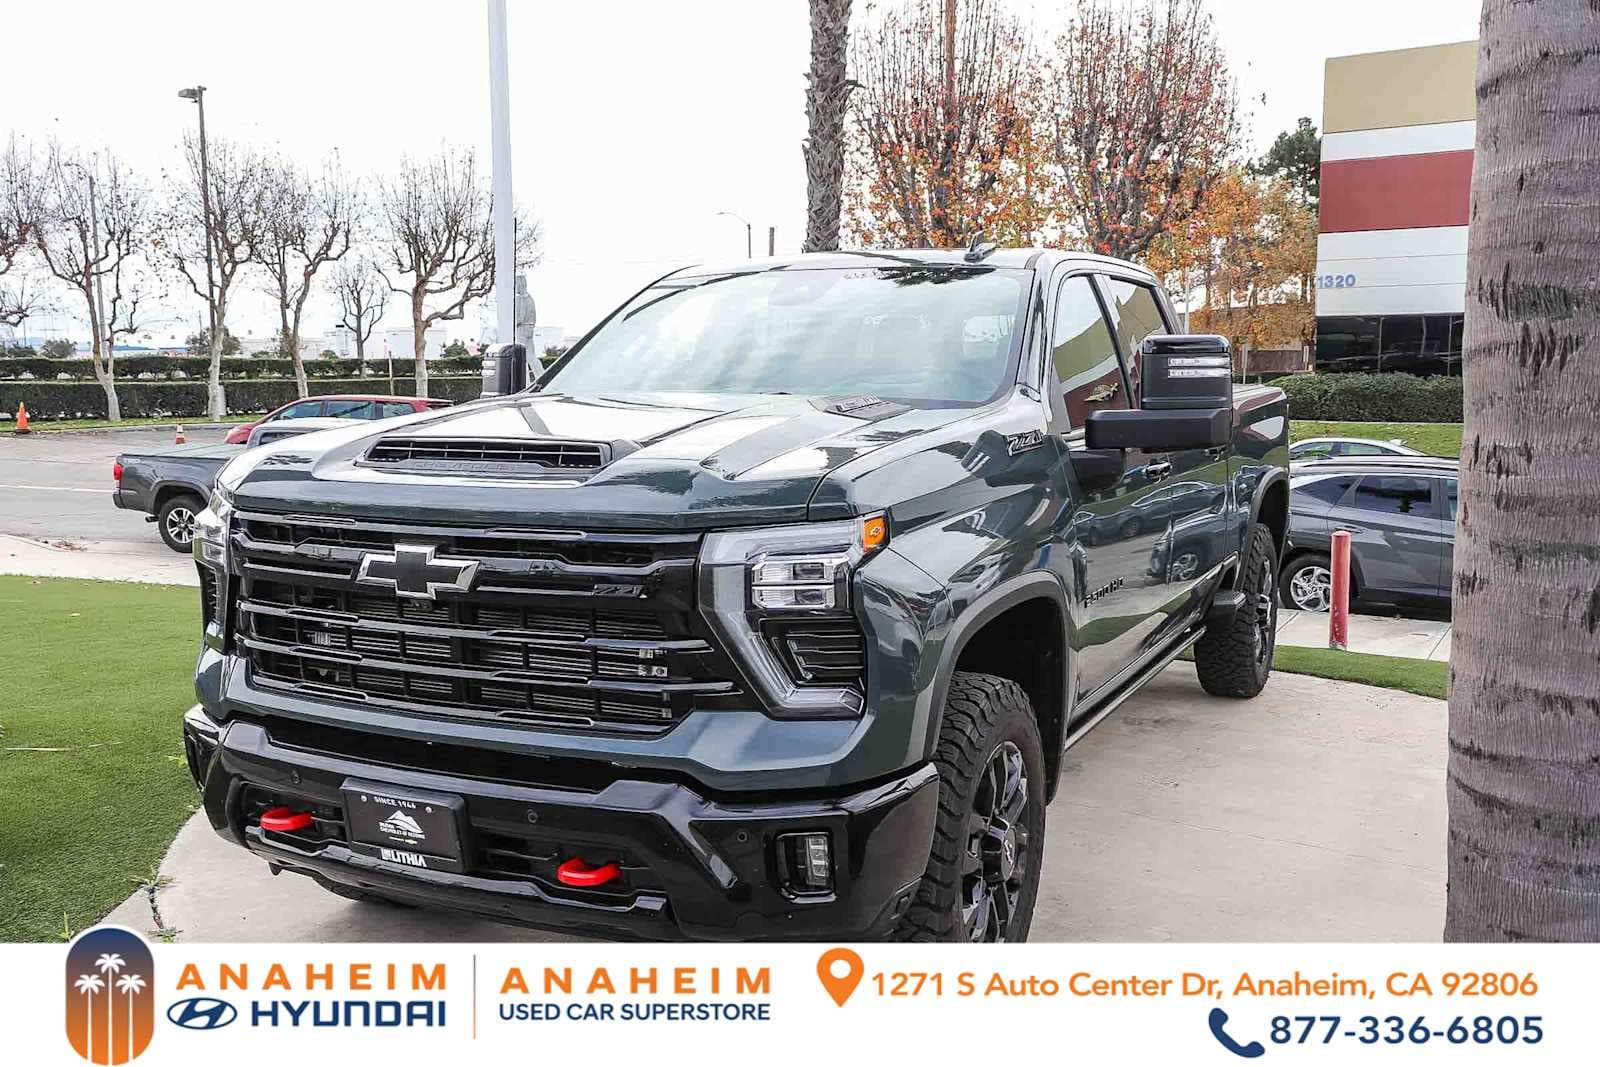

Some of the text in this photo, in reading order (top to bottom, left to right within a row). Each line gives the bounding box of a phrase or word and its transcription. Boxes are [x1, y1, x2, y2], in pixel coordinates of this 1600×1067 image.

[1317, 275, 1356, 288] 1320
[374, 796, 398, 807] SINCE
[390, 849, 428, 868] LITHIA
